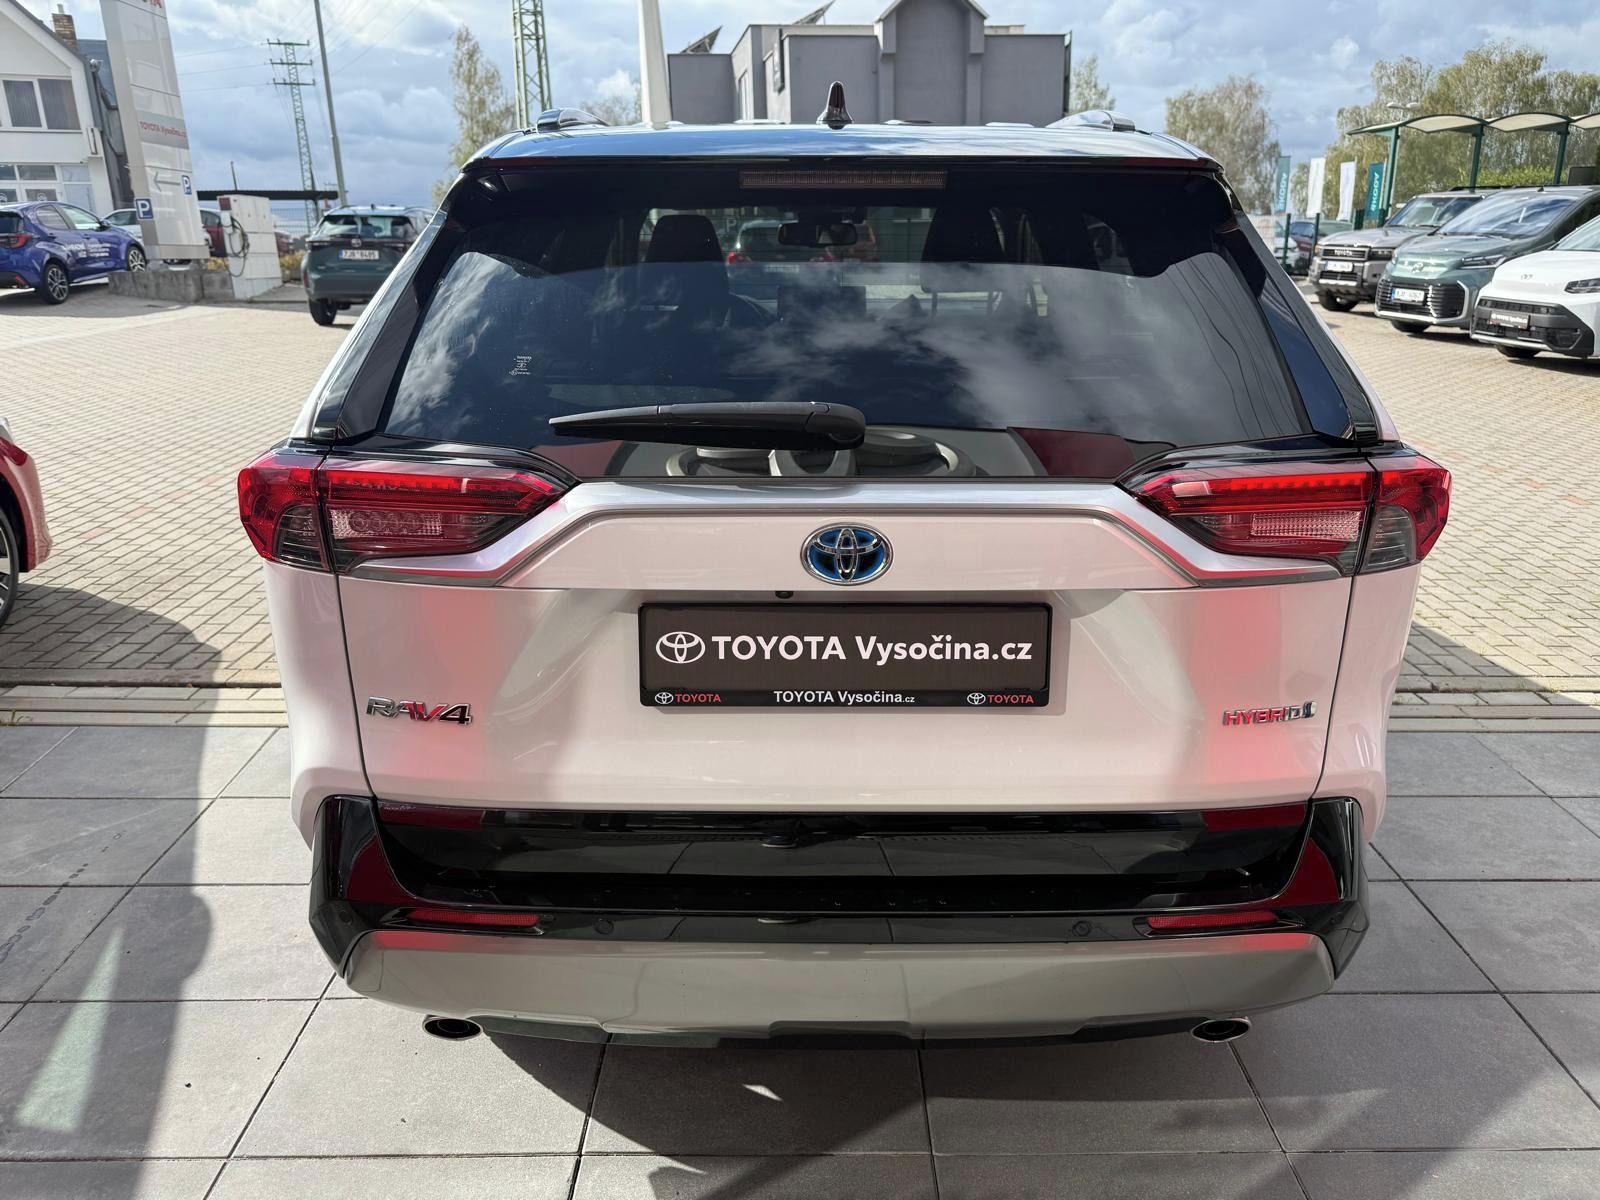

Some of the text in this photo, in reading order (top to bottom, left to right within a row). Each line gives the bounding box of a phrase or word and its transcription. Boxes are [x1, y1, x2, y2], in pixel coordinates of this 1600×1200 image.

[137, 201, 149, 218] P
[711, 634, 1033, 666] TOYOTA Vysočina.cz
[675, 693, 721, 704] TOYOTA
[773, 690, 915, 706] TOYOTA Vysočina.cz
[987, 694, 1034, 704] TOYOTA
[366, 696, 473, 726] RAV4
[1223, 706, 1303, 726] HYBRID
